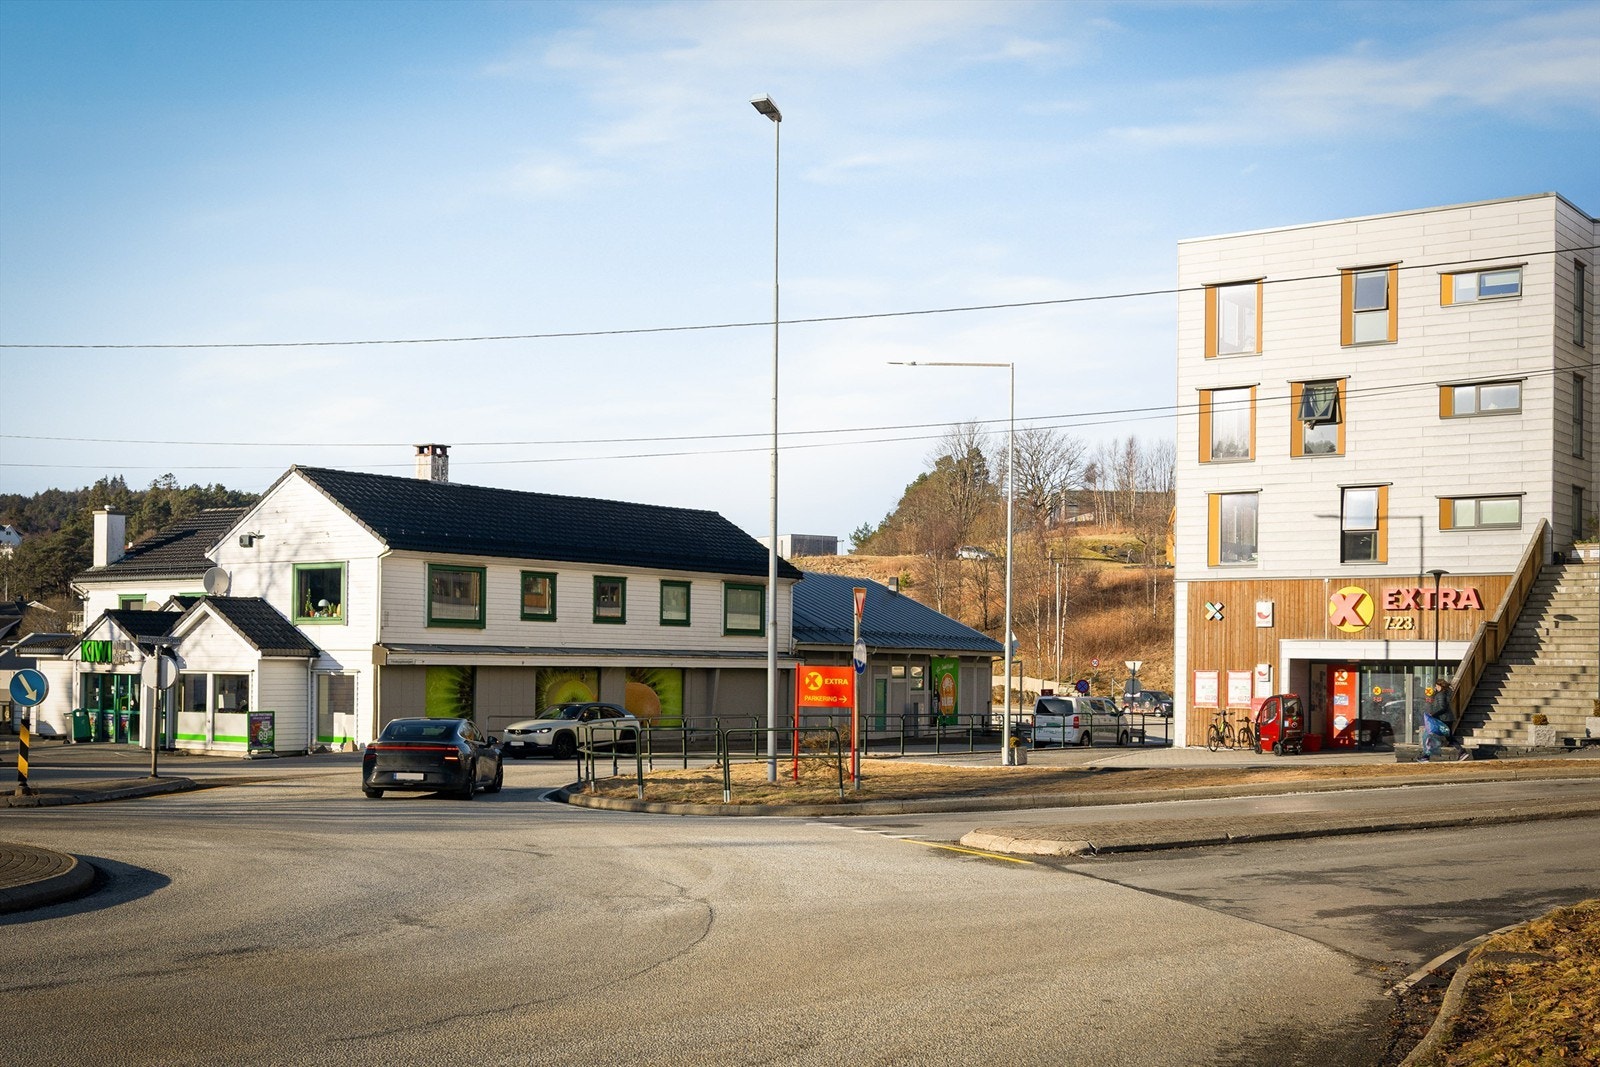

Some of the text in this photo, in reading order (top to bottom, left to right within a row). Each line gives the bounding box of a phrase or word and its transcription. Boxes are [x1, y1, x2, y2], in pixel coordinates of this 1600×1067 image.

[1382, 588, 1483, 610] EXTRA
[81, 640, 112, 662] KIWI
[824, 678, 849, 686] EXTRA
[804, 695, 838, 703] PARKERING
